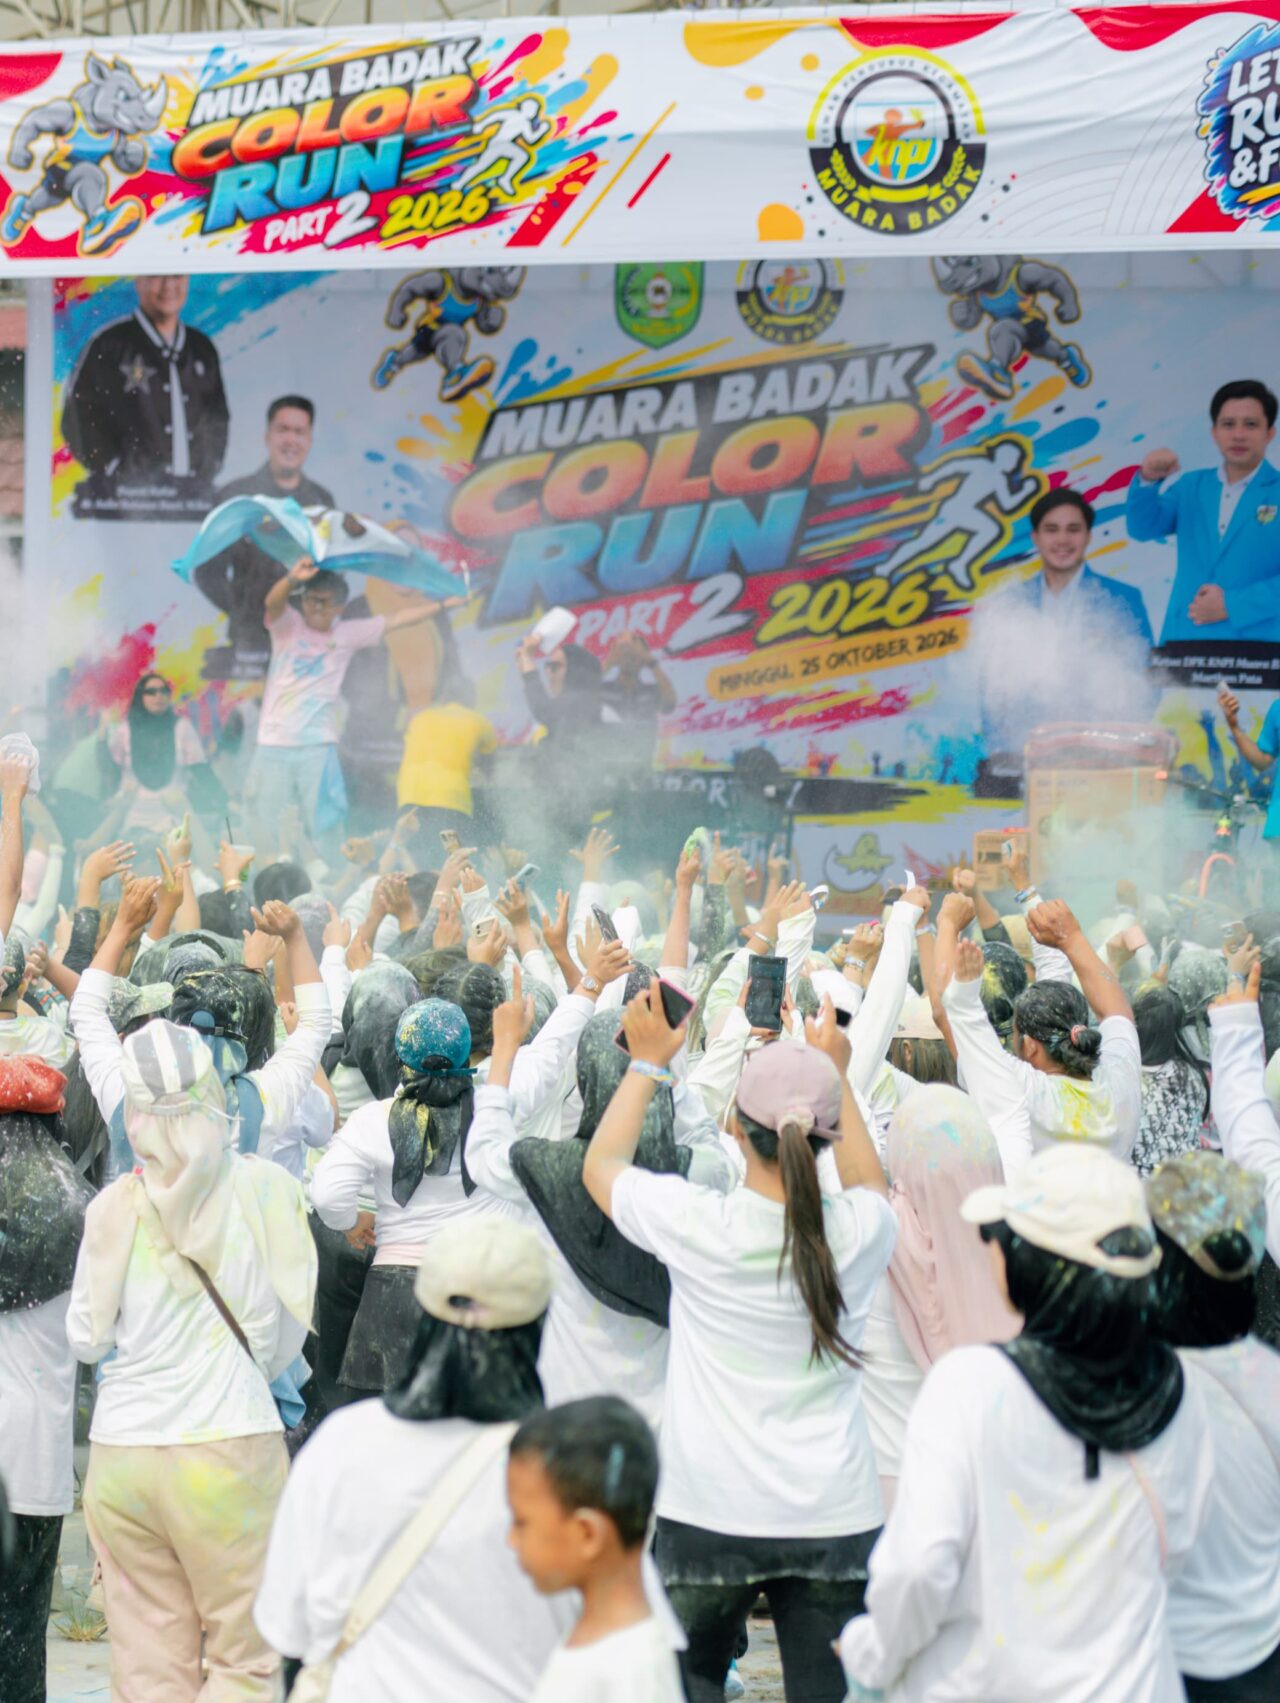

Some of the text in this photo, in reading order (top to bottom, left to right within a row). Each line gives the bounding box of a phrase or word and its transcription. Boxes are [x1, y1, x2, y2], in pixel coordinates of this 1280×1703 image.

[172, 73, 476, 180] COLOR
[190, 40, 480, 126] MUARA BADAK
[201, 134, 405, 233] RUN
[263, 187, 490, 250] PART 2 2026
[816, 164, 983, 232] MUARA BADAK
[482, 350, 925, 460] MUARA BADAK
[451, 402, 921, 540] COLOR
[484, 489, 809, 622] RUN
[574, 571, 930, 654] PART 2 2026
[800, 656, 821, 677] 25
[825, 637, 913, 669] OKTOBER
[916, 627, 960, 654] 2026
